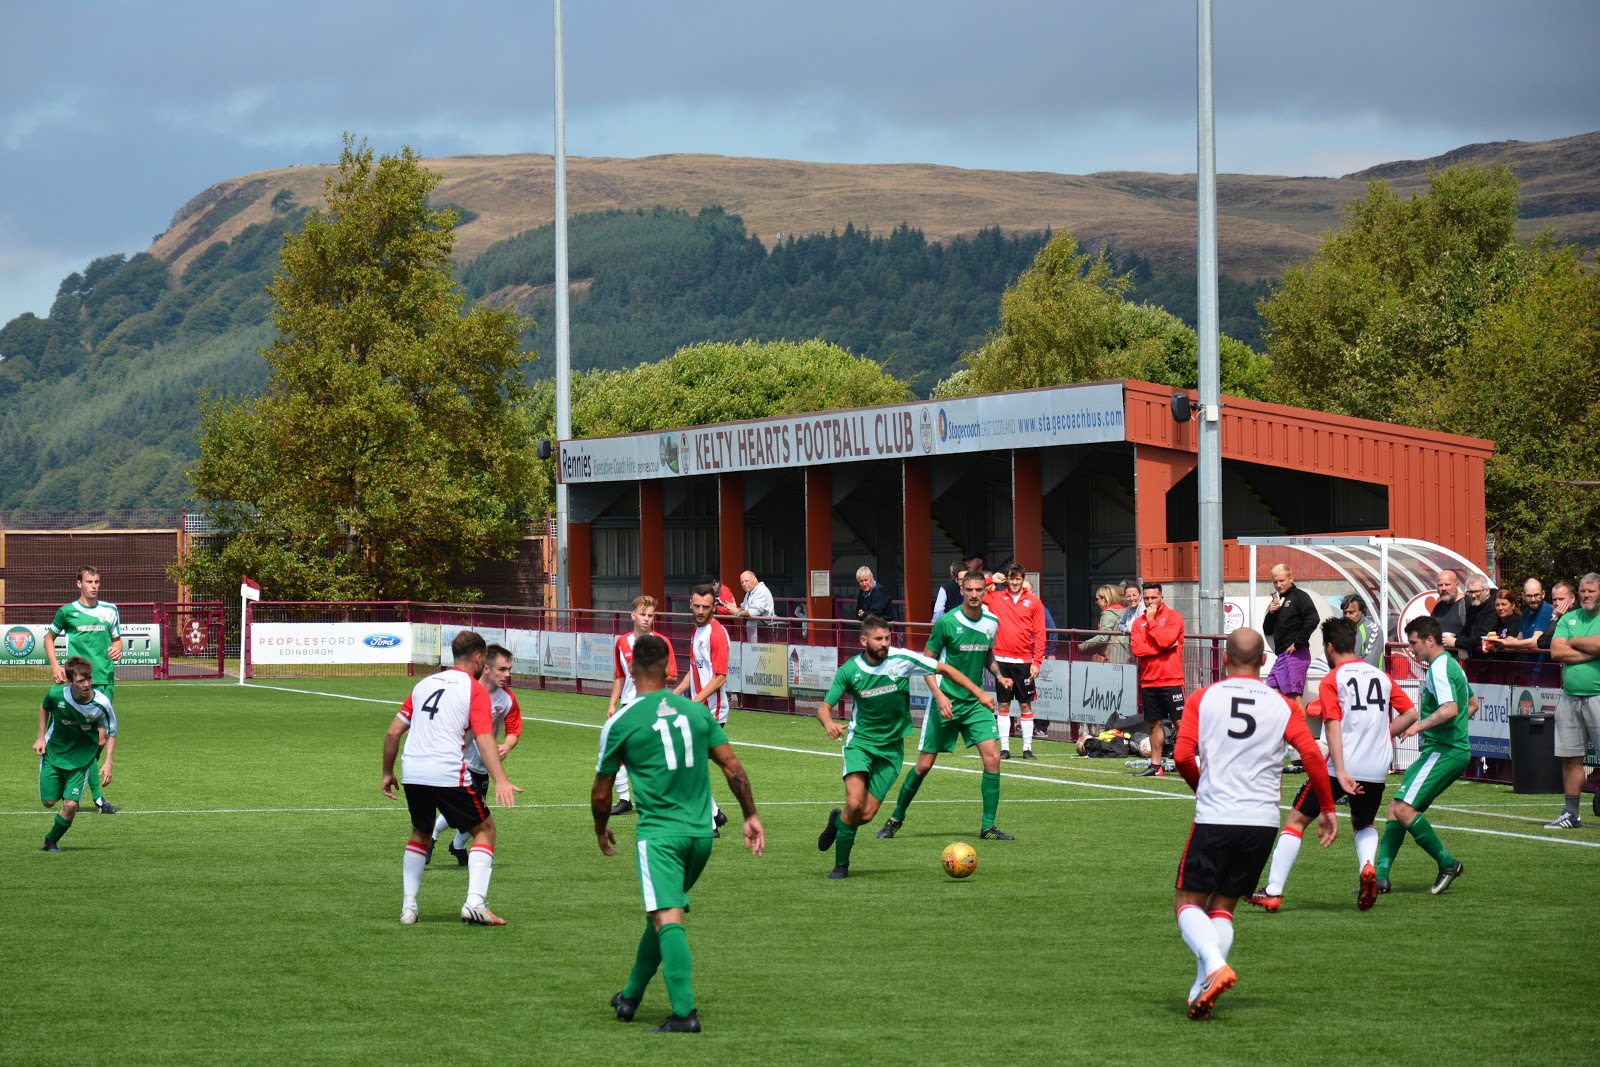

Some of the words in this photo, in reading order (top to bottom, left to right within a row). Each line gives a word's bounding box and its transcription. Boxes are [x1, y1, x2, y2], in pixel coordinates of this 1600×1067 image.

[948, 420, 980, 445] Stagecoach
[1018, 408, 1122, 436] www.stagecoachbus.com
[695, 431, 732, 470] KELTY
[738, 424, 790, 466] HEARTS
[795, 415, 870, 462] FOOTBALL
[875, 412, 914, 455] CLUB
[563, 446, 592, 478] Rennies
[614, 458, 626, 474] Coach
[627, 456, 635, 474] Hire
[279, 648, 334, 656] EDINBURGH
[370, 635, 395, 647] Ford
[421, 688, 446, 720] 4
[1082, 664, 1124, 712] Lomond
[1346, 677, 1386, 712] 14
[1227, 696, 1257, 740] 5
[1478, 696, 1509, 723] Travel
[651, 714, 694, 771] 11
